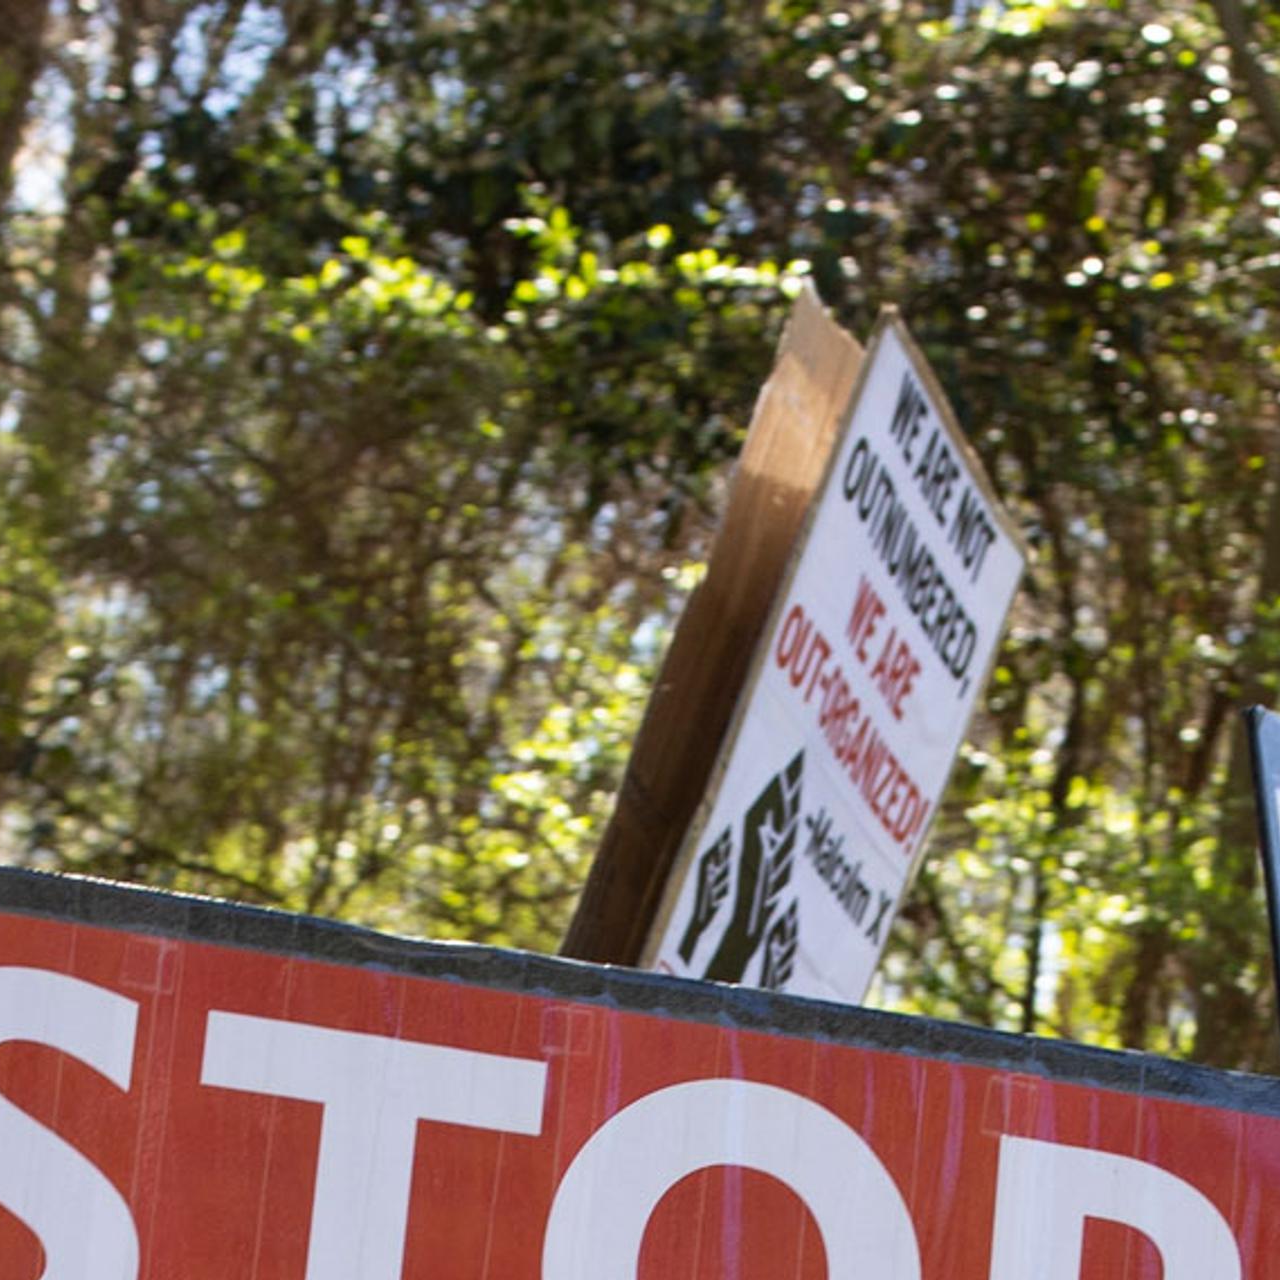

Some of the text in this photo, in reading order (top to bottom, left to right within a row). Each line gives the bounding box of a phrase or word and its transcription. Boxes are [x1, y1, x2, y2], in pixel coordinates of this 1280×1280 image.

[890, 368, 997, 585] WE ARE NOT
[843, 436, 978, 700] OUTNUMBERED,
[846, 574, 922, 721] WE ARE
[866, 890, 892, 946] X
